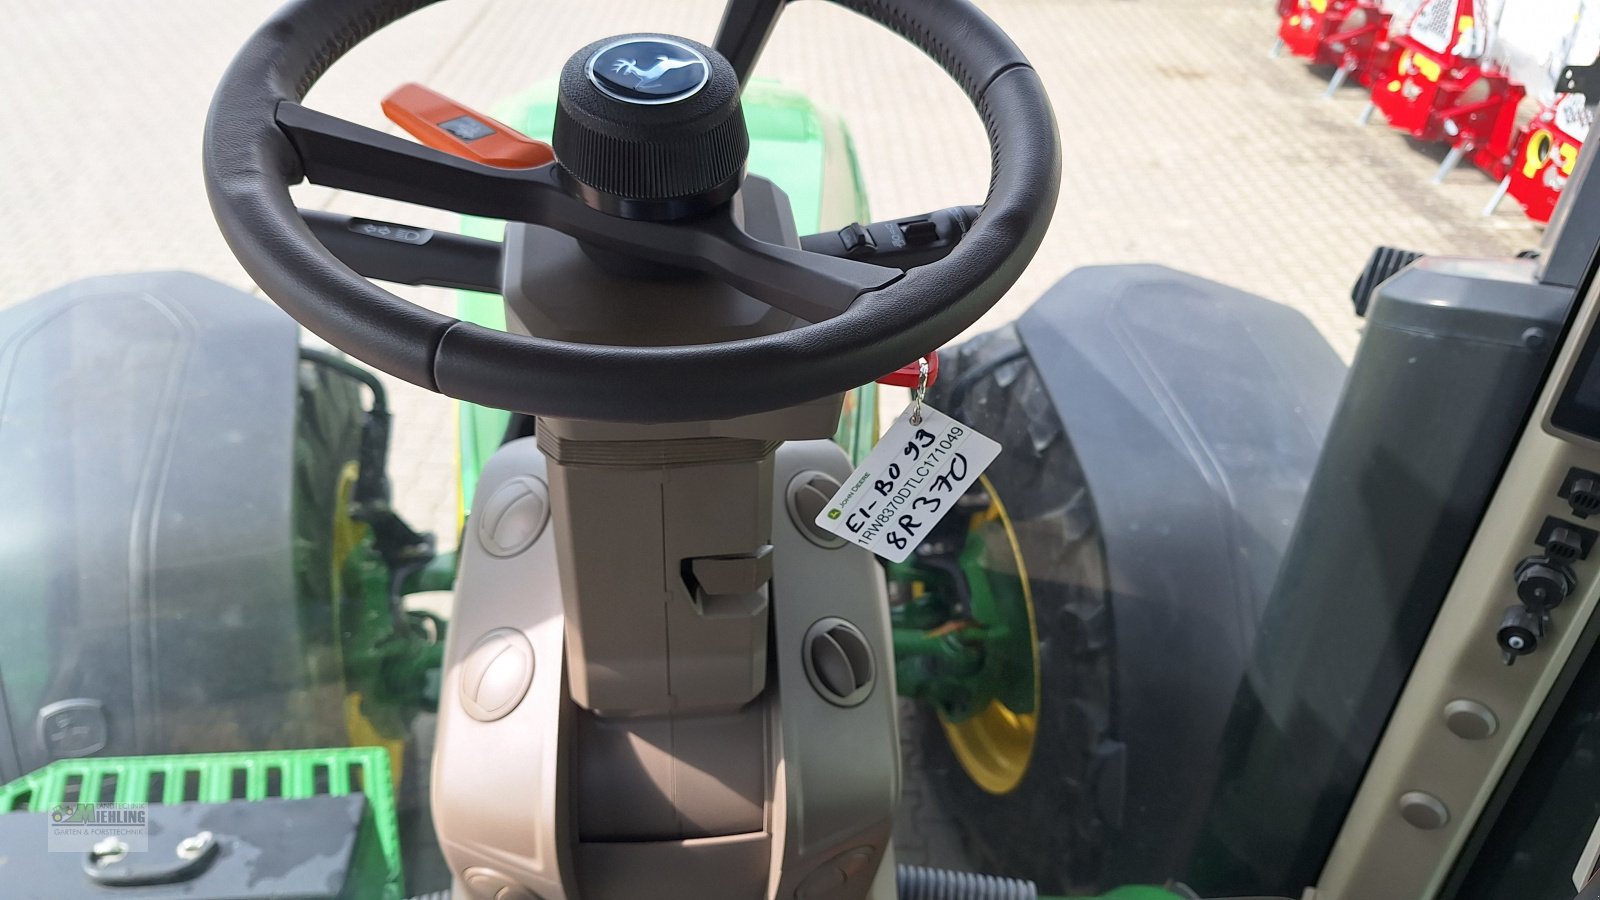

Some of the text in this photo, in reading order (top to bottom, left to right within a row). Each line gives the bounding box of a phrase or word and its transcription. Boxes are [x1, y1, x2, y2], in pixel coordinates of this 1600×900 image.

[839, 472, 871, 509] JOHN DEERE
[858, 426, 964, 545] 1RW8370DTLC171049
[886, 452, 967, 550] 8R 370
